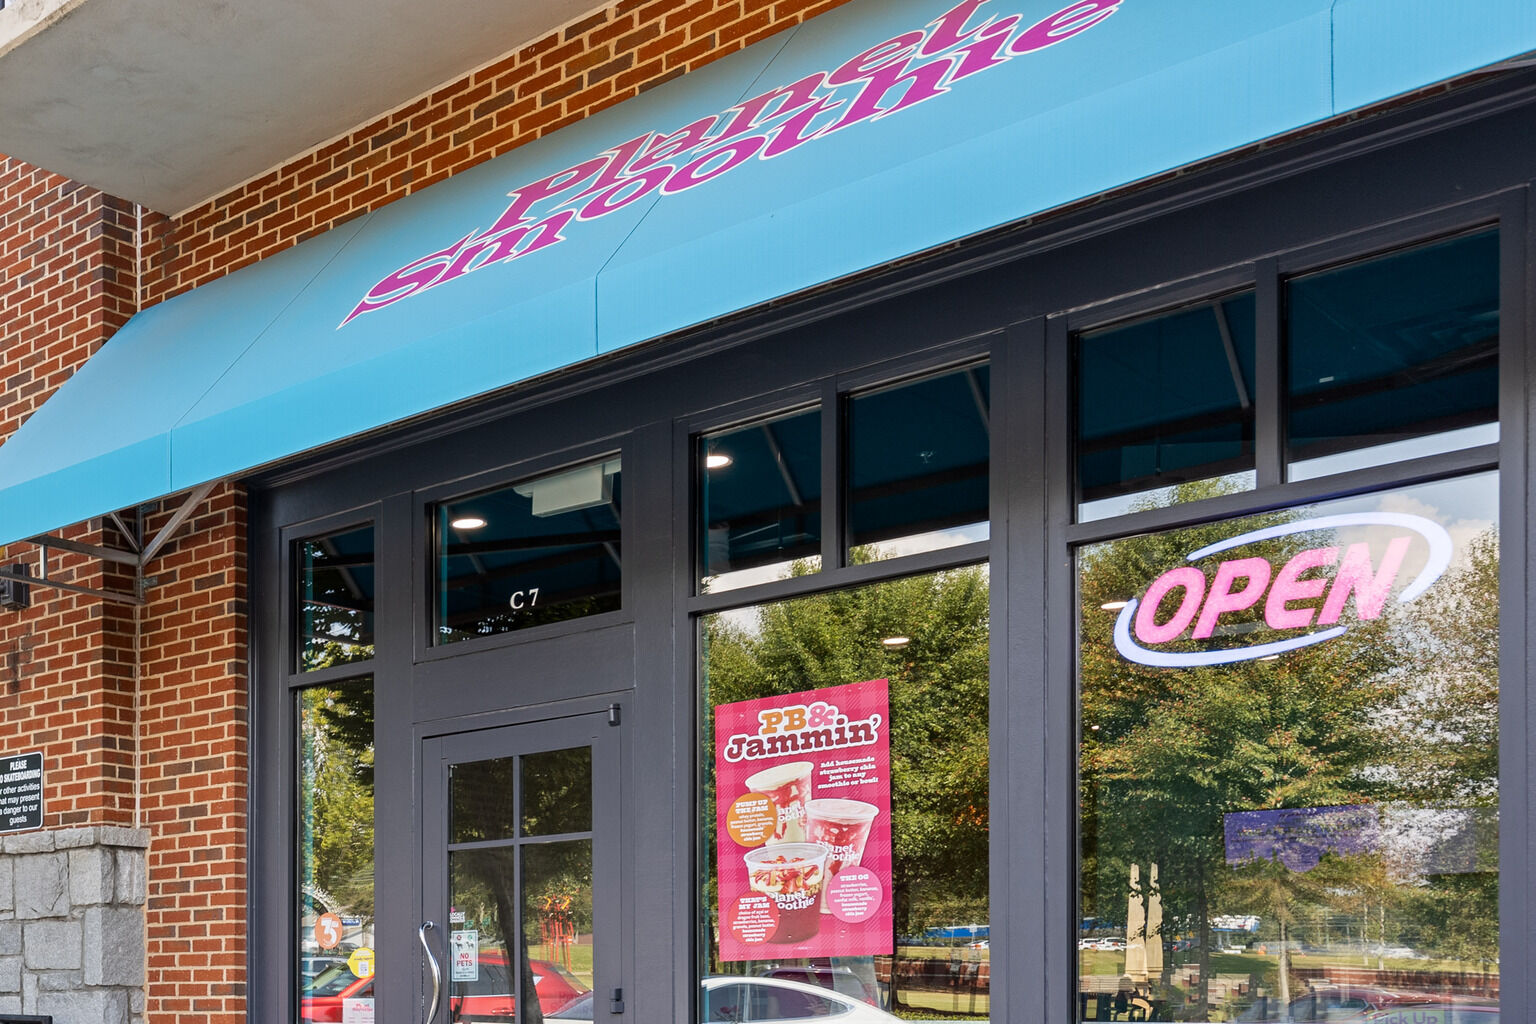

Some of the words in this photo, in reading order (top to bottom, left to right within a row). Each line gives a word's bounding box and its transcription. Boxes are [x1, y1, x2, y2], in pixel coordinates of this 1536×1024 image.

[464, 0, 998, 240] Planet
[337, 0, 1124, 330] Smoothie
[1135, 536, 1411, 644] OPEN
[761, 705, 835, 734] PB&
[727, 717, 880, 760] Jammin'
[9, 760, 27, 771] PLEASE
[4, 769, 40, 783] SKATEBOARDING
[3, 786, 16, 795] other
[17, 783, 40, 793] activities
[20, 793, 40, 804] present
[3, 806, 22, 815] danger
[9, 816, 27, 826] guests
